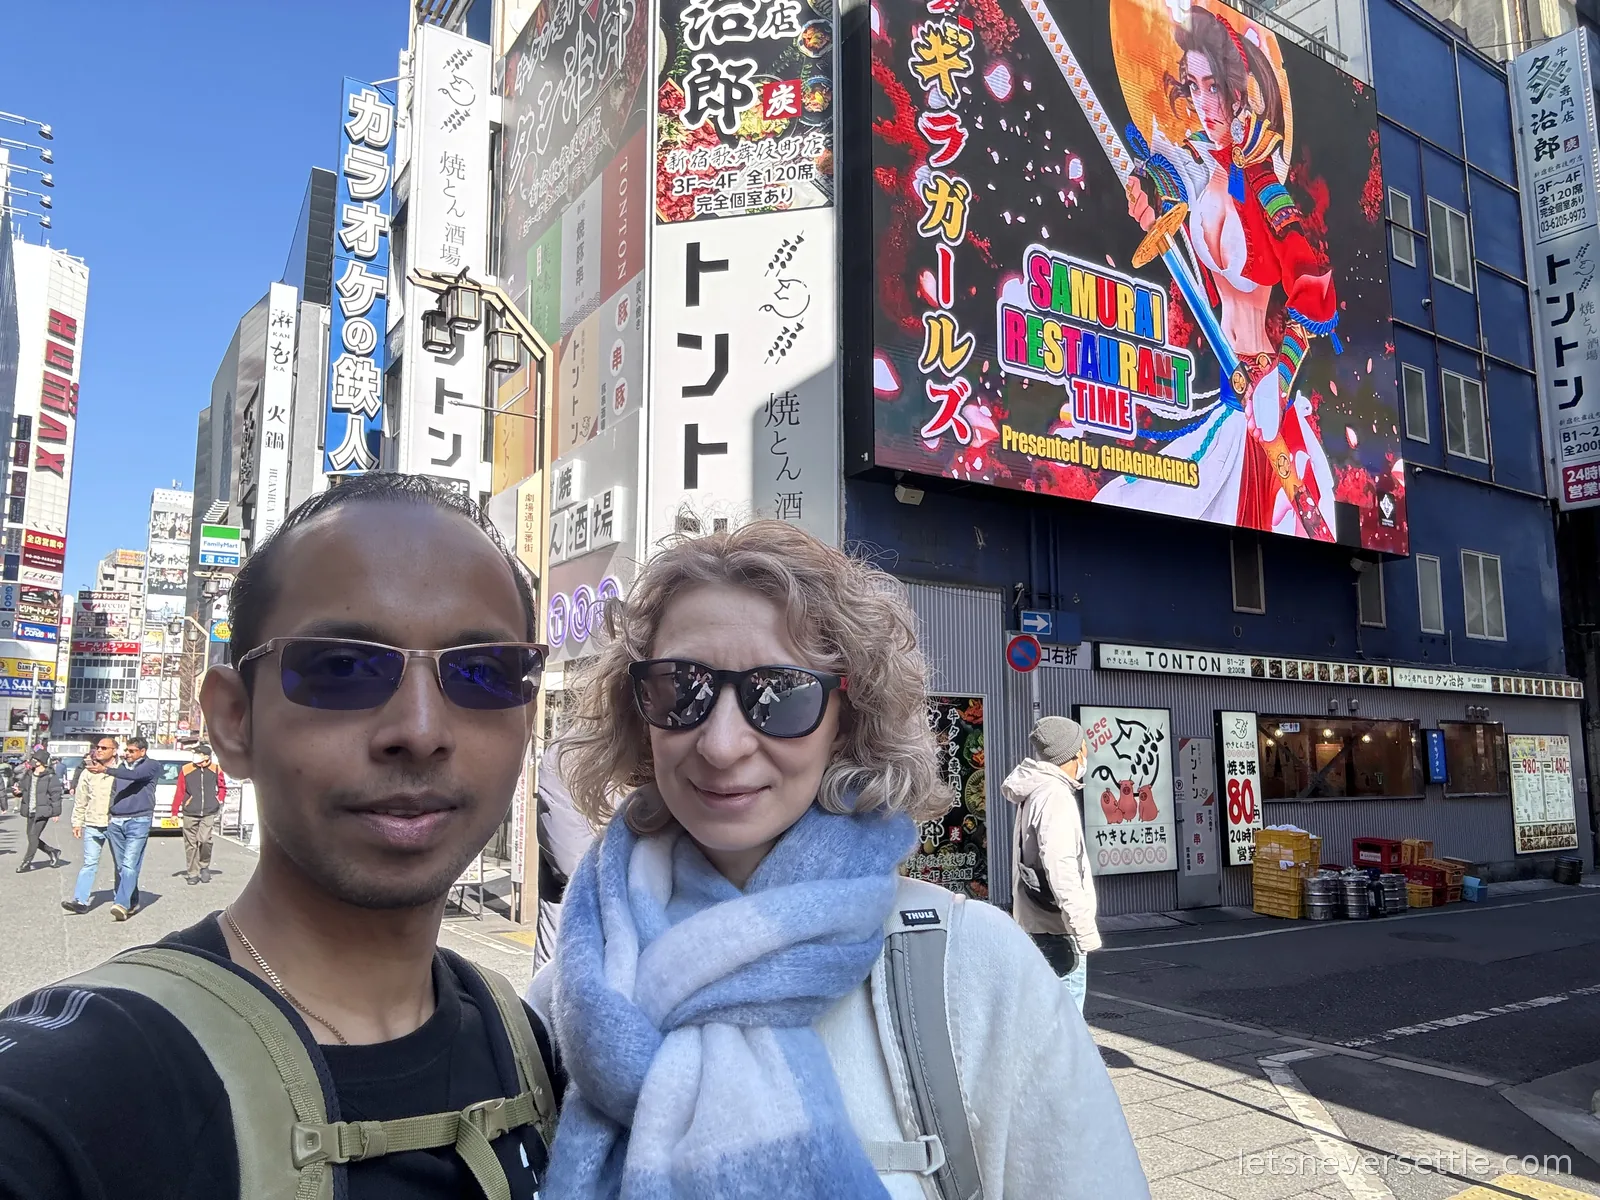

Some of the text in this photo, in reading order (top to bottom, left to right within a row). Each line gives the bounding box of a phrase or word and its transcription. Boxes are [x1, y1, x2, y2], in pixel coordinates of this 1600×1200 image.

[766, 85, 797, 117] 炭
[1556, 46, 1575, 124] 牛タン専門店
[666, 134, 826, 173] 新宿歌舞伎町店
[747, 166, 815, 188] 全120席
[439, 151, 467, 266] 焼とん酒場
[696, 187, 794, 213] 完全個室あり
[1538, 187, 1584, 208] 全120席
[1539, 195, 1585, 219] 完全個室あり
[617, 156, 629, 280] TONTON
[1540, 208, 1587, 233] 03-6205-9973
[328, 88, 395, 472] カラオケの鉄人
[1030, 254, 1163, 343] SAMURAI
[272, 331, 291, 340] KAN
[1546, 254, 1584, 411] トントン
[1579, 301, 1600, 361] 焼とん酒場
[273, 365, 286, 373] KA
[1004, 308, 1190, 407] RESTAURANT
[35, 308, 80, 479] HUMAX
[571, 340, 580, 445] トントン
[676, 241, 729, 533] トント
[1072, 380, 1132, 431] TIME
[264, 405, 287, 451] 火鍋
[764, 390, 804, 520] 焼とん酒
[1002, 424, 1199, 487] Presented by GIRAGIRAGIRLS
[1564, 441, 1600, 457] 全200
[1567, 465, 1600, 483] 24時
[1568, 481, 1600, 499] 営業
[524, 492, 535, 554] 劇場通り一番街
[549, 490, 613, 556] ん酒場
[27, 534, 65, 549] 全店営業中
[203, 541, 238, 549] FamilyMart
[217, 556, 236, 564] たばこ
[32, 662, 46, 672] PNIC
[1145, 651, 1221, 673] TONTON
[1085, 716, 1108, 738] see
[1090, 727, 1113, 753] you
[1190, 744, 1199, 800] トントン
[1227, 760, 1257, 776] 焼き豚
[1227, 778, 1255, 825] 80
[1095, 827, 1167, 847] やきとん酒場
[905, 911, 934, 920] THULE
